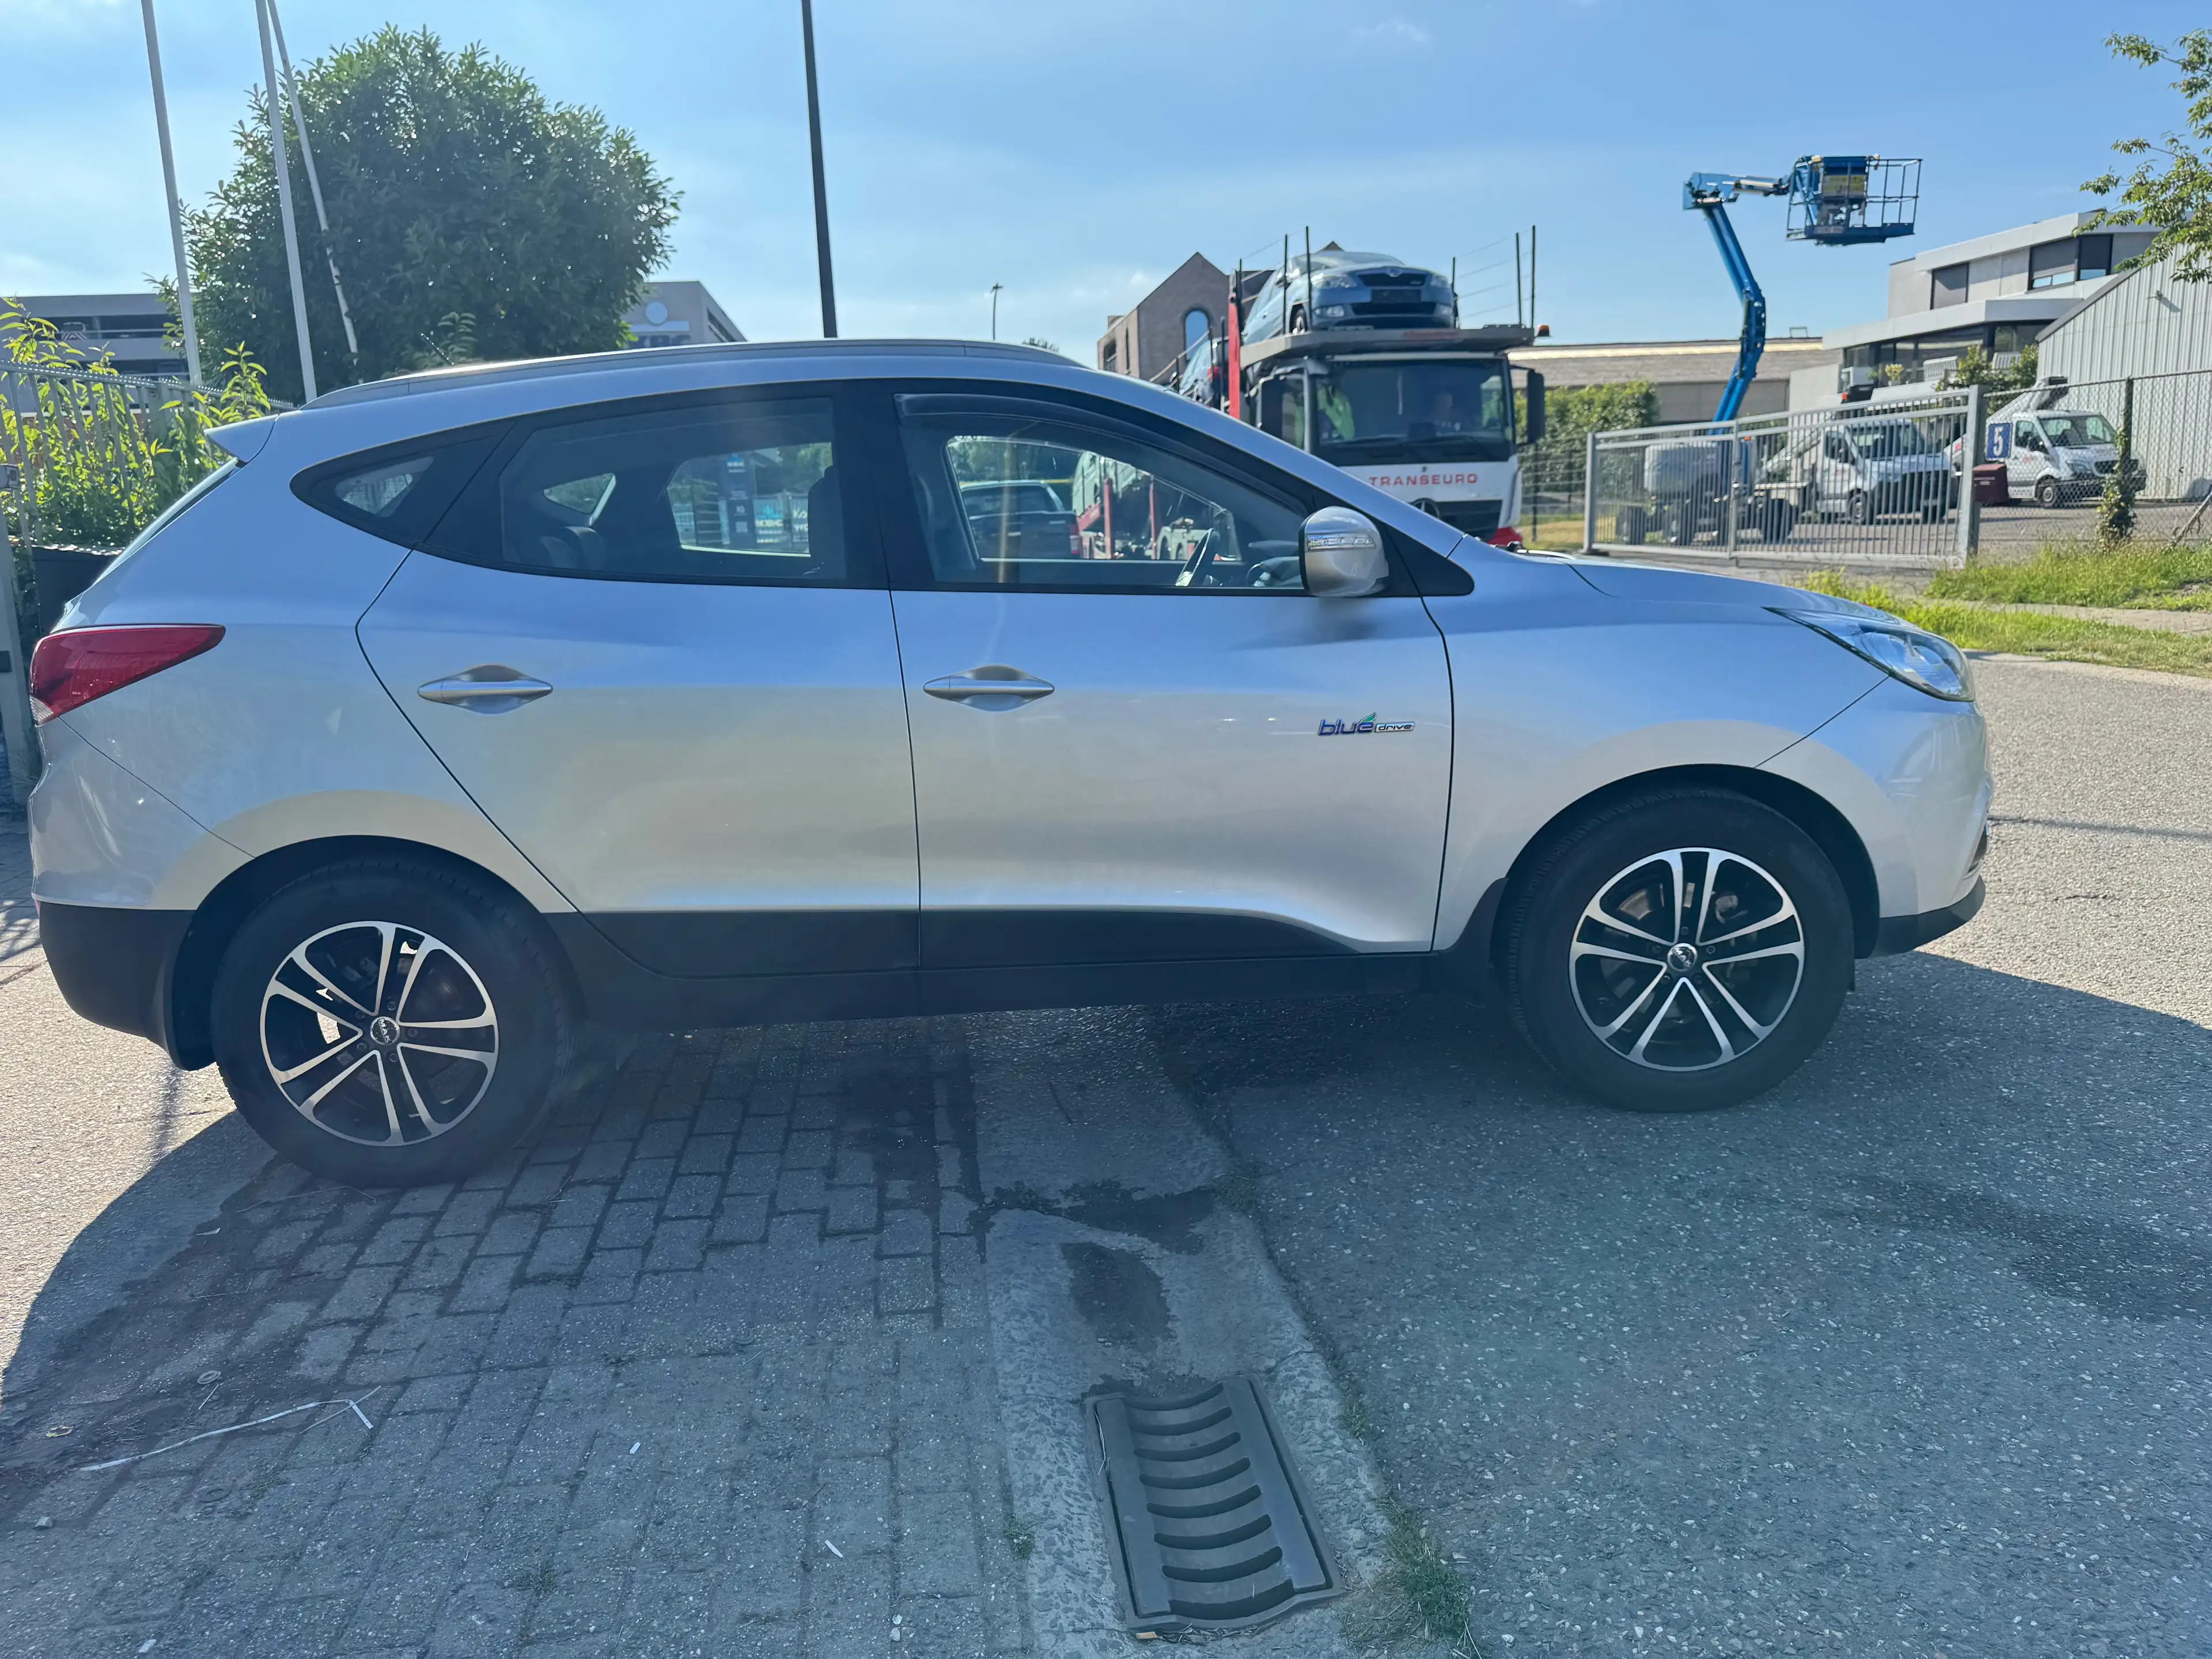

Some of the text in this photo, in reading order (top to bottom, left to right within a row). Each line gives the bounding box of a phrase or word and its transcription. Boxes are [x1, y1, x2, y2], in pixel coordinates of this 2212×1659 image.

[1993, 426, 2003, 456] 5
[1369, 473, 1478, 487] TRANSEURO
[1318, 718, 1374, 736] blue
